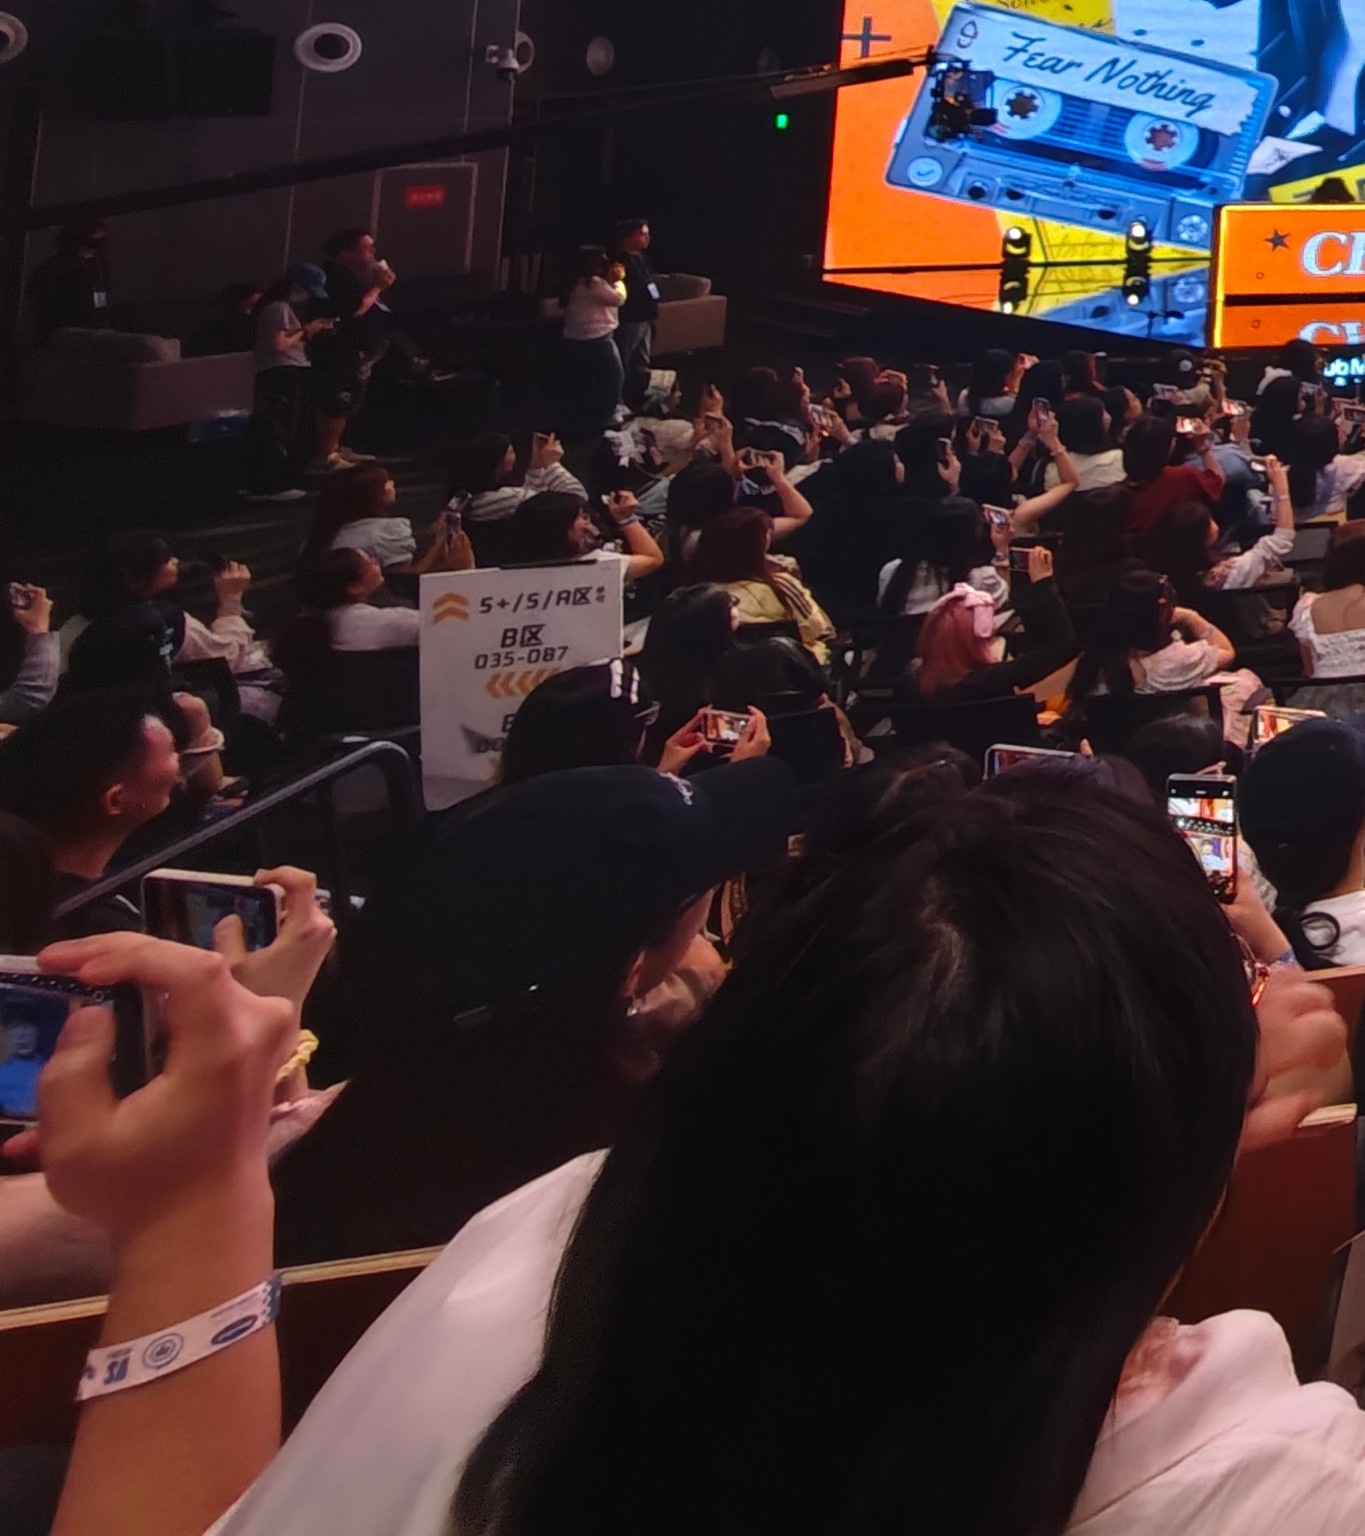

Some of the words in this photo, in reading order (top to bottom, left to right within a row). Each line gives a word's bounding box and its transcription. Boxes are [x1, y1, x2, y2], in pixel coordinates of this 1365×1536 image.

[1003, 31, 1083, 74] Fear
[1085, 57, 1217, 118] Nothing
[500, 624, 546, 648] B区
[474, 646, 569, 669] 035-087
